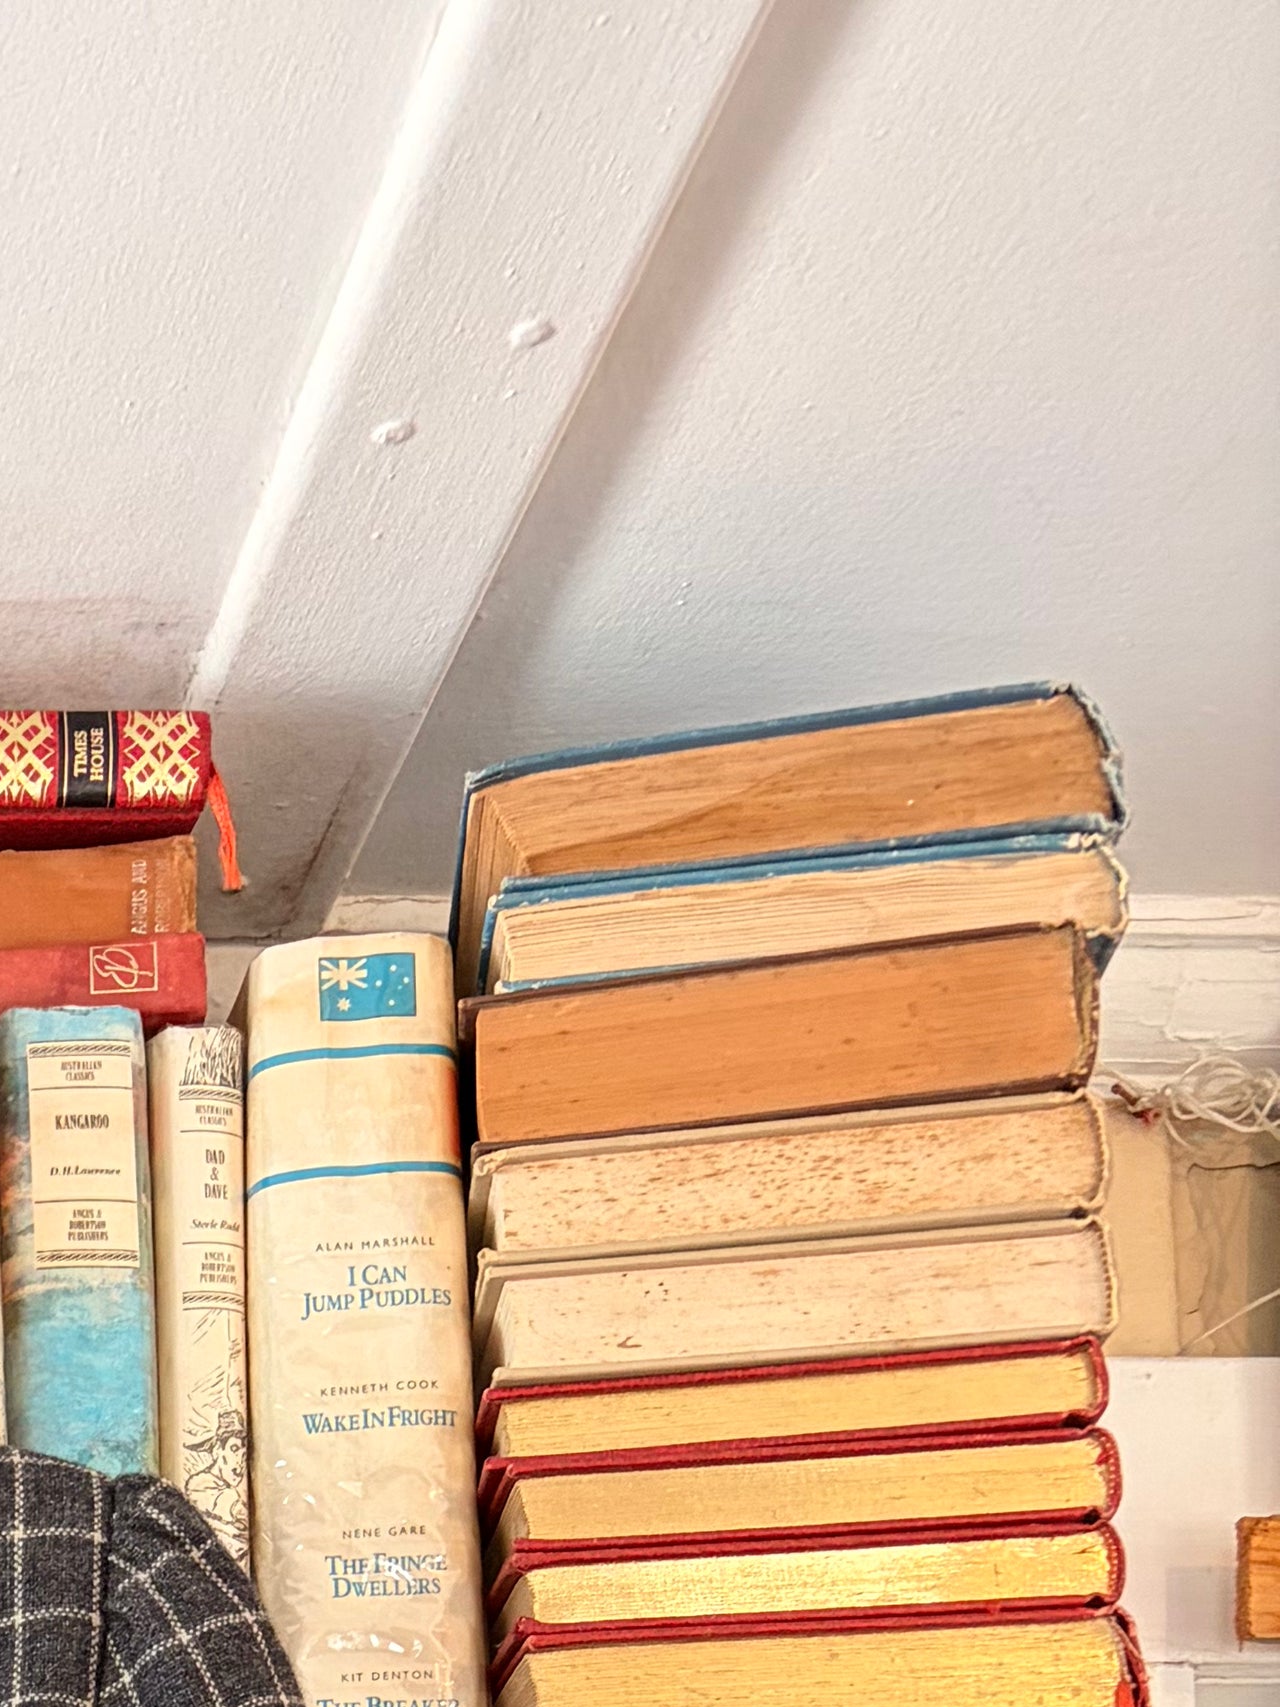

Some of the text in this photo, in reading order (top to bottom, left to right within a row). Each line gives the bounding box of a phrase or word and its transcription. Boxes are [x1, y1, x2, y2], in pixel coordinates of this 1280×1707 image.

[73, 730, 88, 778] TIMES
[89, 727, 104, 781] HOUSE
[54, 1113, 111, 1131] KANGAROO
[315, 1235, 437, 1252] ALAN MARSHALL
[301, 1285, 453, 1320] JUMP PUDDLES
[319, 1378, 440, 1397] KENNETH COOK
[302, 1404, 459, 1435] WAKE IN FRIGHT
[341, 1524, 428, 1540] NENE GARE
[331, 1577, 442, 1600] DWELLERS
[340, 1668, 435, 1683] KIT DENTON
